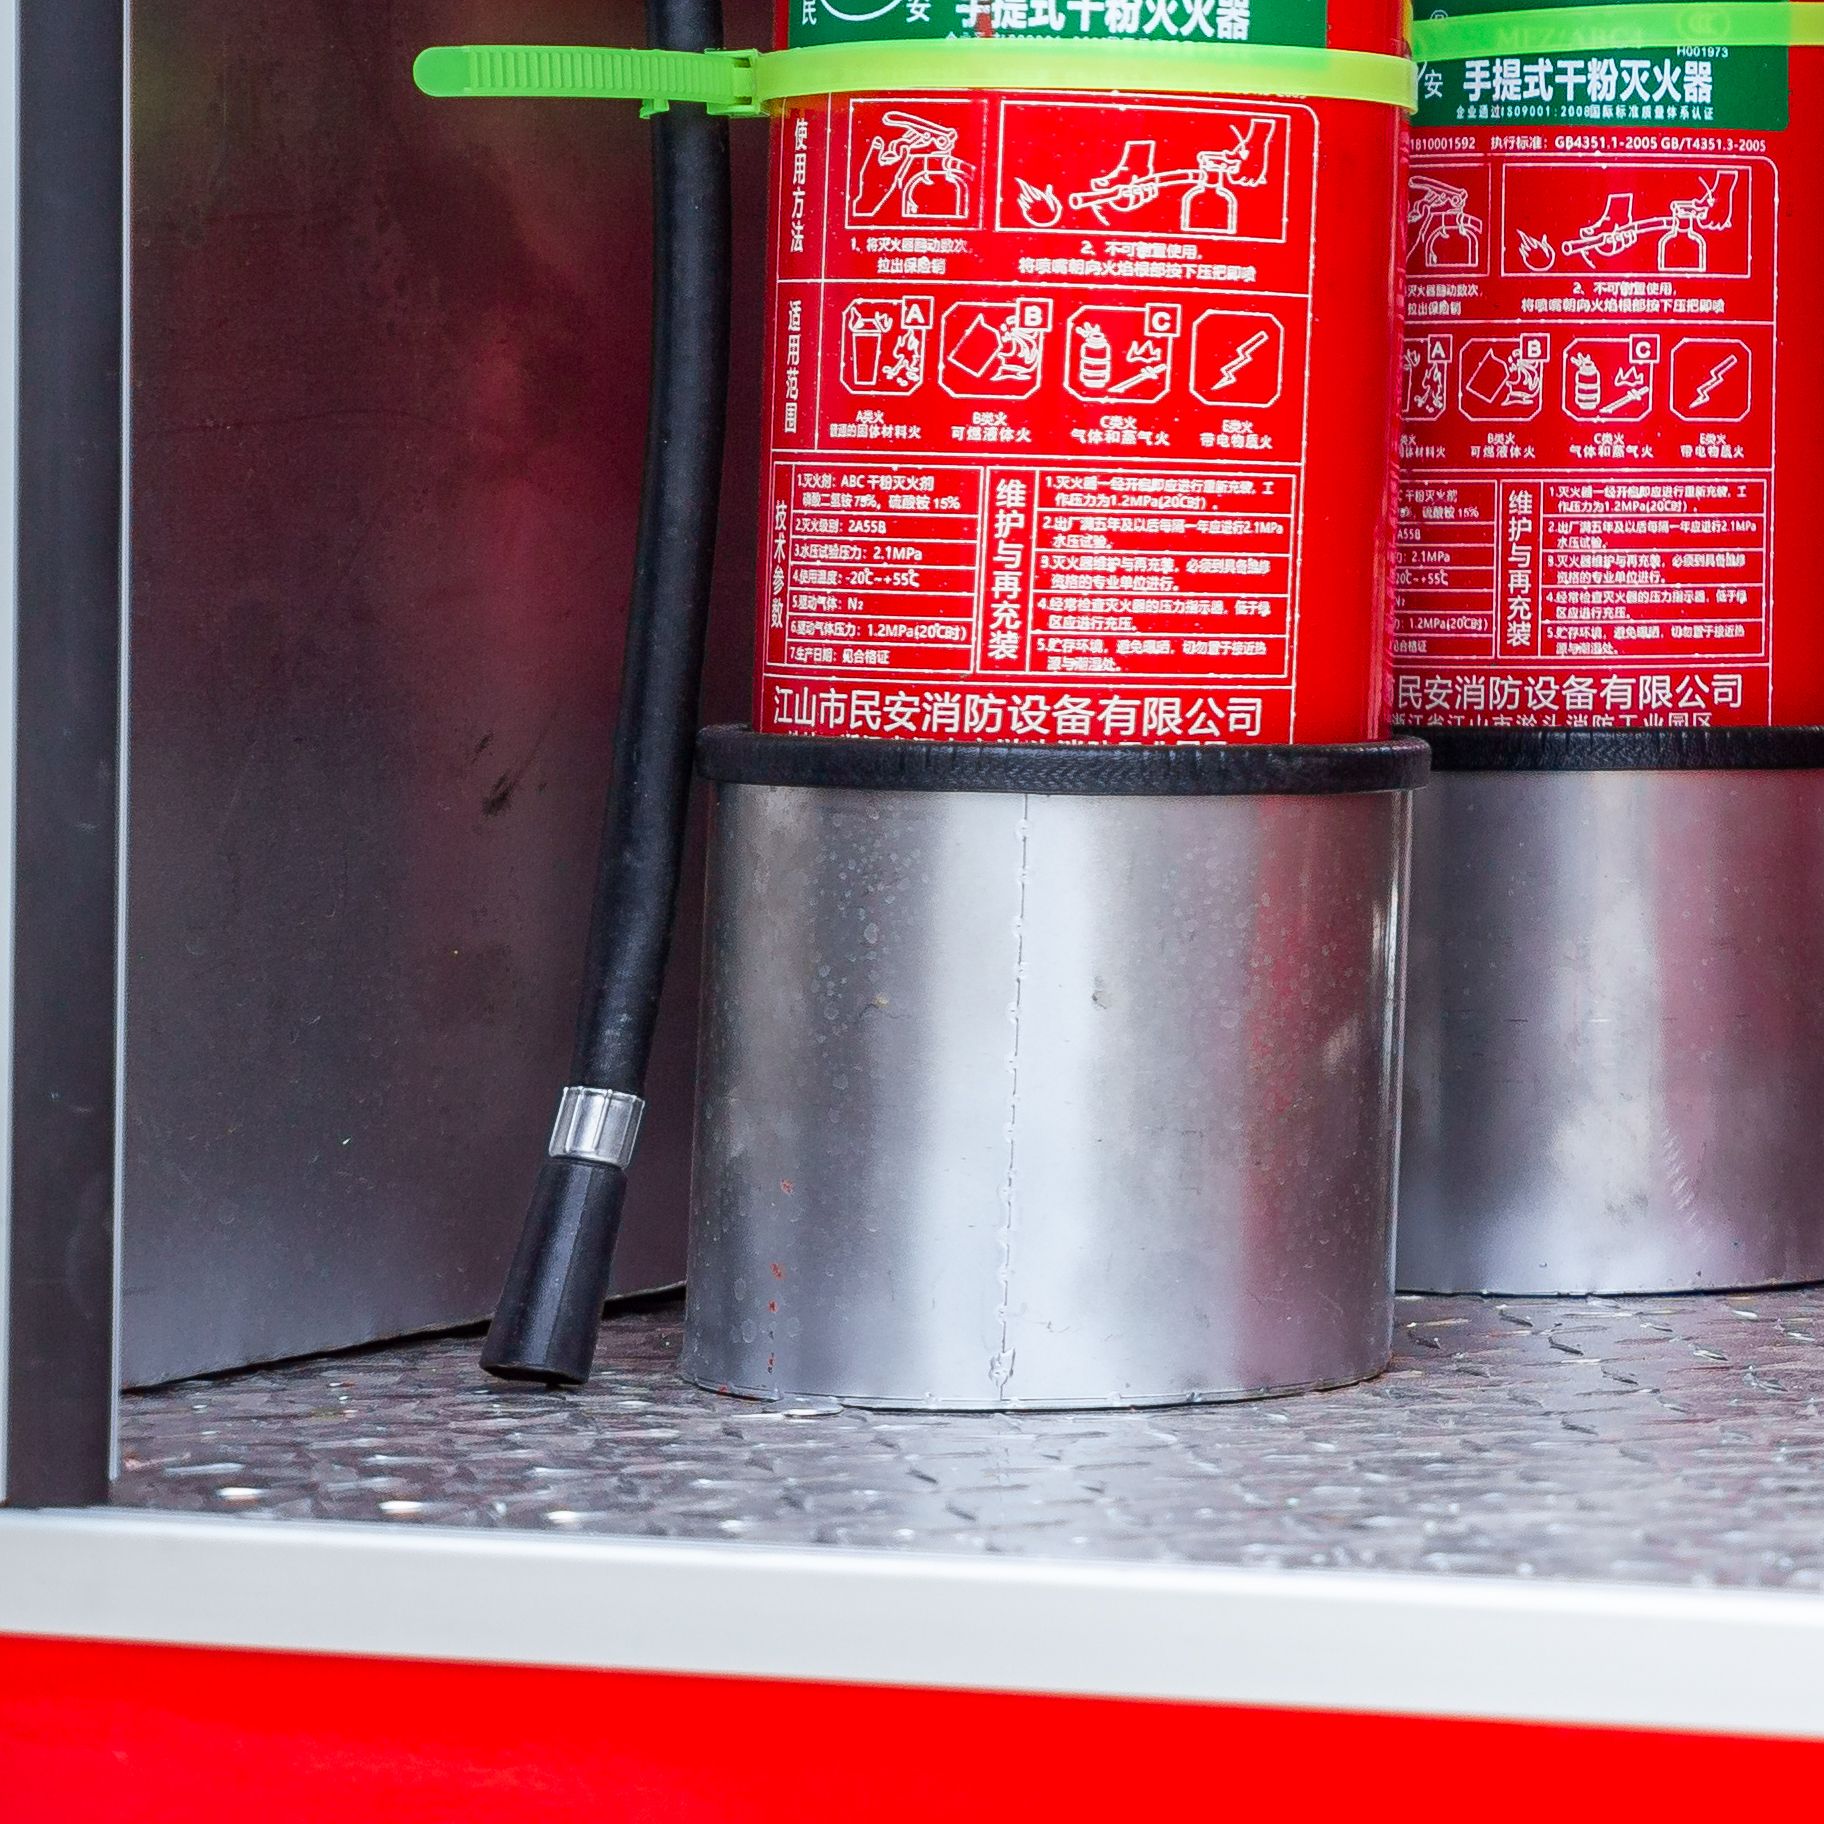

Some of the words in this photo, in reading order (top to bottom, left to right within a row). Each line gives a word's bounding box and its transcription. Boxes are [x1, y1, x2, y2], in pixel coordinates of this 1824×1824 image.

[1463, 57, 1714, 103] 手提式干粉灭火器
[789, 118, 808, 254] 使用方法
[905, 303, 925, 324] A
[1024, 305, 1043, 326] B
[1151, 311, 1171, 331] C
[784, 300, 802, 435] 适用范围
[1431, 342, 1446, 359] A
[1527, 341, 1541, 357] B
[1635, 341, 1651, 358] C
[771, 499, 787, 629] 技术参数
[987, 478, 1026, 661] 维护与再充装
[1506, 489, 1533, 647] 维护与再充装
[773, 685, 1264, 736] 江山市民安消防设备有限公司
[1398, 674, 1743, 710] 民安消防设备有限公司
